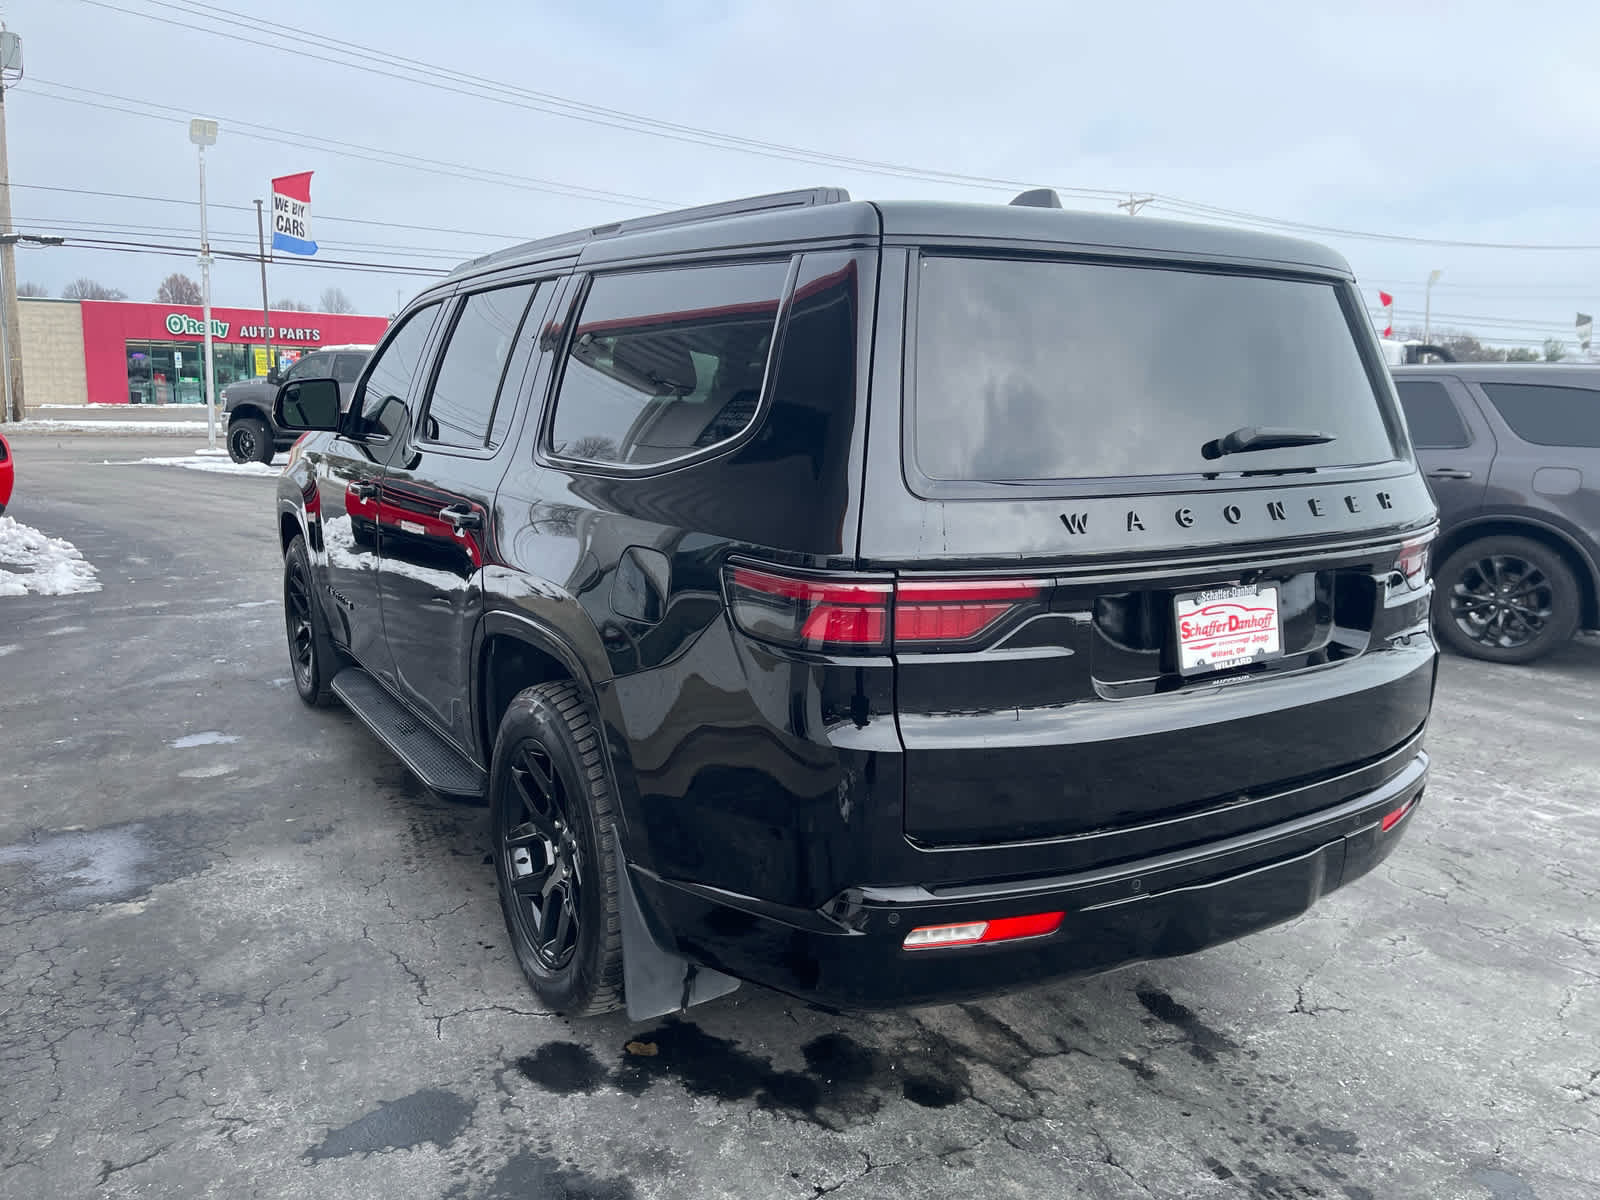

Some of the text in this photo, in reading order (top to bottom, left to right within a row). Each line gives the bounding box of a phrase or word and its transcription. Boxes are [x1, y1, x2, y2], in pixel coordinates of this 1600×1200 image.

[275, 197, 288, 213] WE
[276, 215, 305, 237] CARS
[166, 314, 321, 340] O'Relly AUTO PARTS
[1059, 491, 1392, 534] WAGONEER
[1214, 657, 1253, 670] WILLARD
